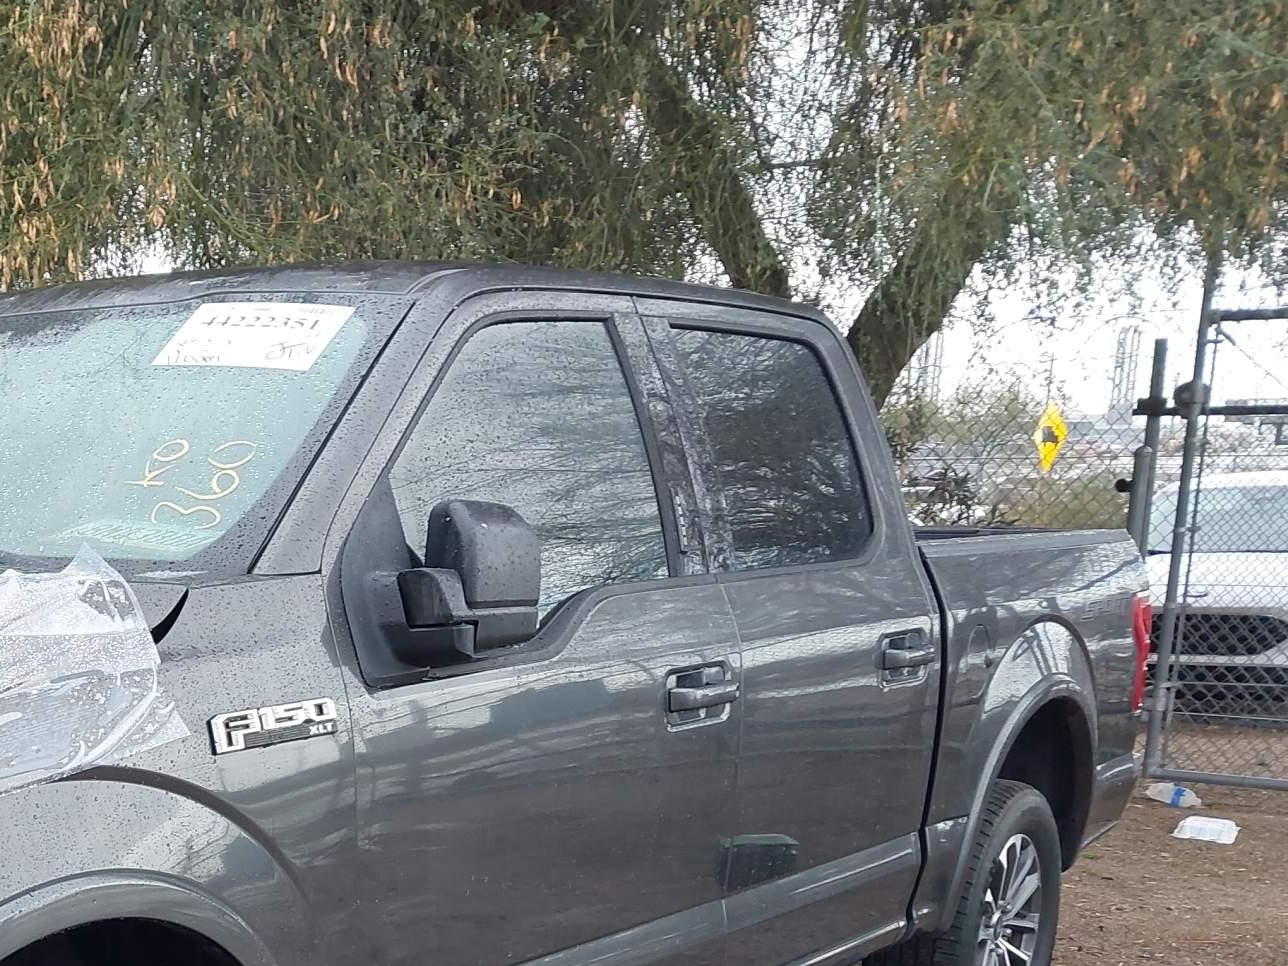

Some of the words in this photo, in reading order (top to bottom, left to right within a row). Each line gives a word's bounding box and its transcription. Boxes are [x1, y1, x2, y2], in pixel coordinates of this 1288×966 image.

[200, 315, 320, 331] 44222351
[151, 440, 258, 531] 360
[307, 722, 334, 736] XLT
